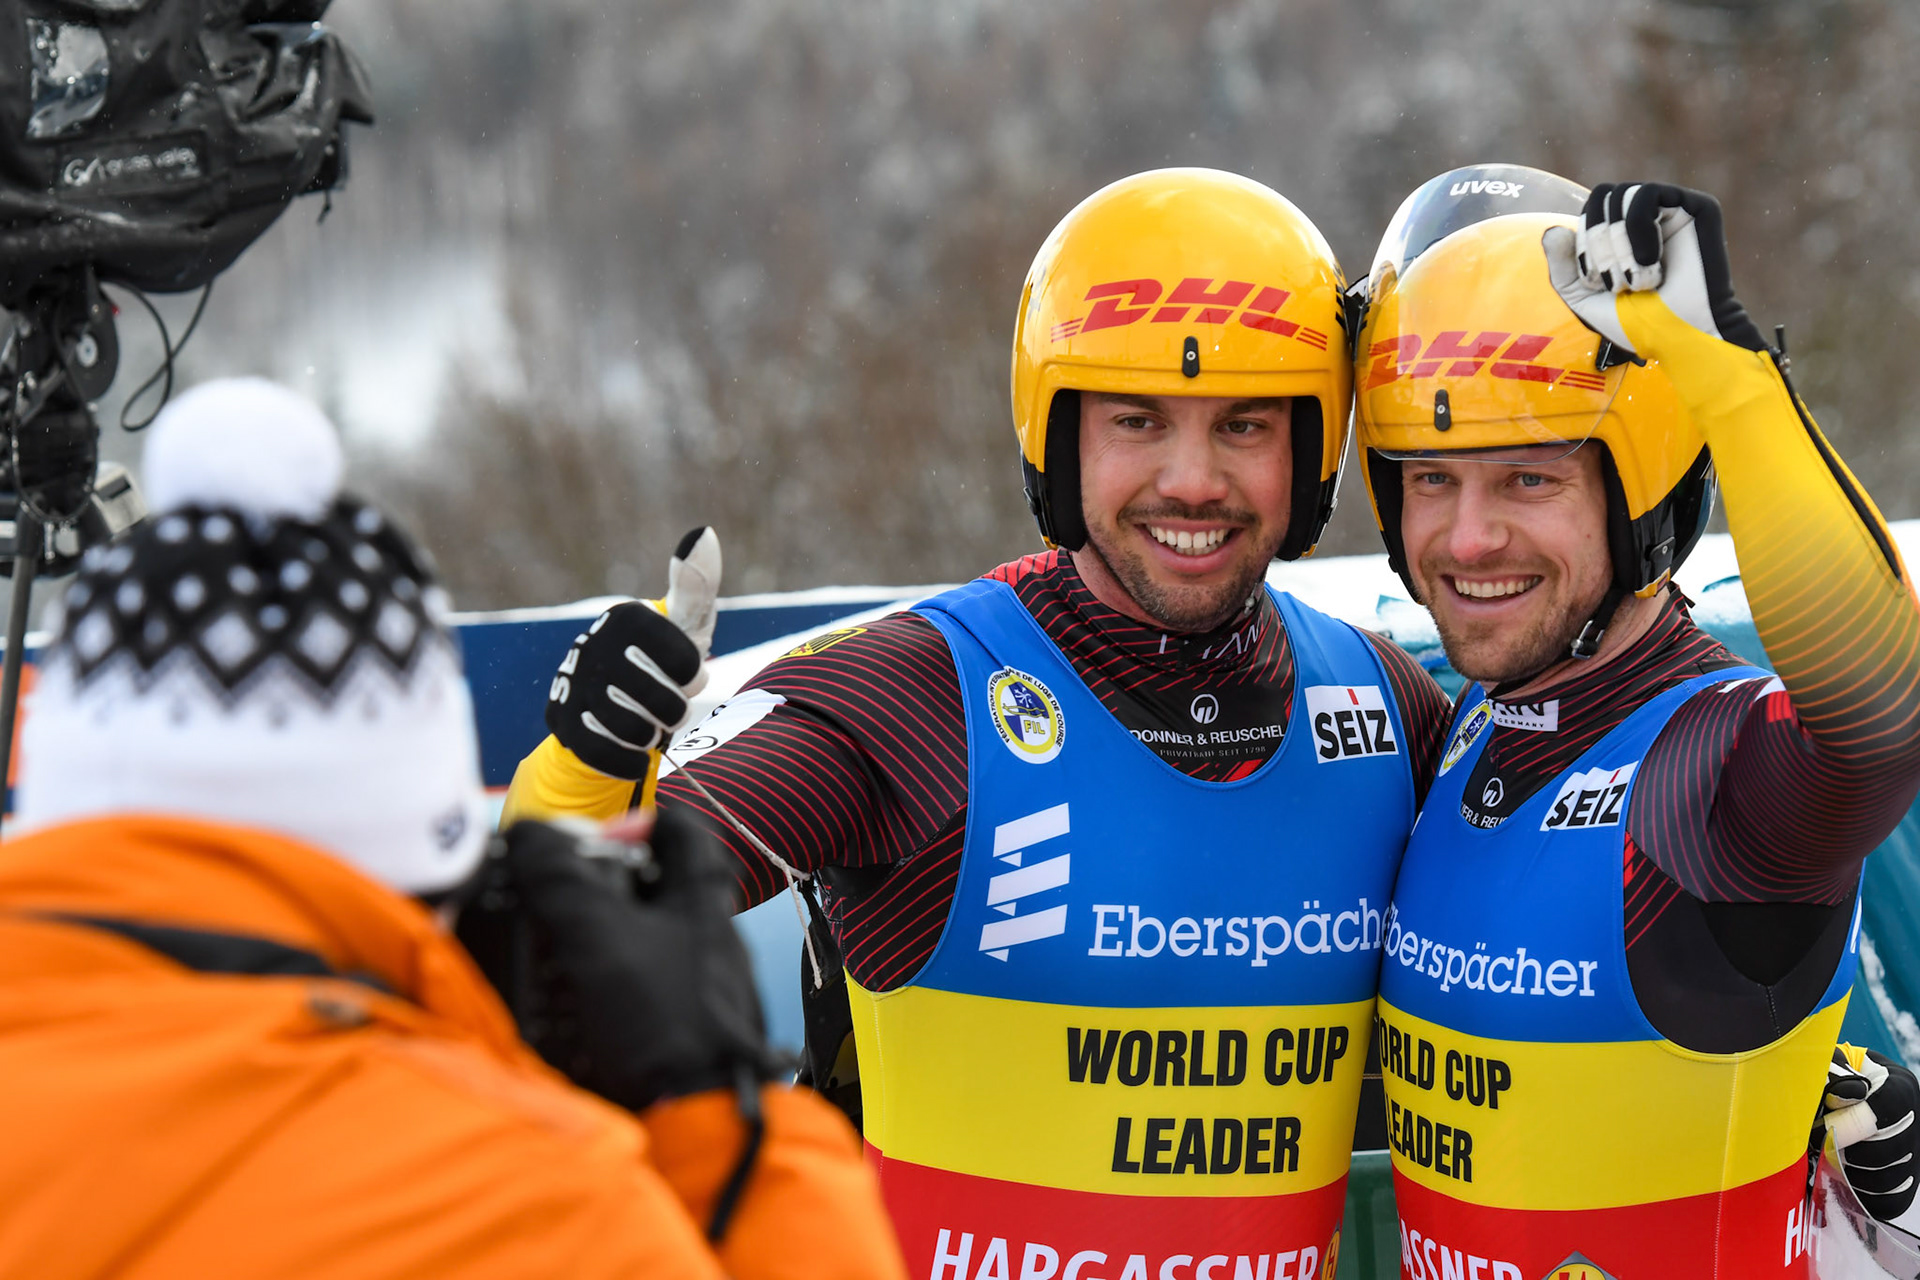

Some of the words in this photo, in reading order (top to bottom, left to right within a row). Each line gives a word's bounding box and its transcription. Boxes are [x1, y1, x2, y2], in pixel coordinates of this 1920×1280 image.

[1450, 179, 1524, 198] uvex
[1081, 278, 1300, 338] DHL
[1364, 331, 1566, 391] DHL
[1033, 681, 1053, 700] LUGE
[1023, 719, 1046, 735] FIL
[1130, 729, 1194, 746] DONNER
[1197, 733, 1208, 745] &
[1210, 725, 1285, 744] REUSCHEL
[1315, 709, 1396, 759] SEIZ
[1498, 717, 1545, 728] GERMANY
[1546, 783, 1627, 828] SEIZ
[1088, 898, 1389, 967] Eberspäch
[1385, 901, 1598, 997] berspächer
[1067, 1027, 1248, 1087] WORLD
[1264, 1026, 1349, 1086] CUP
[1379, 1017, 1435, 1091] ORLD
[1445, 1049, 1511, 1110] CUP
[1111, 1116, 1301, 1175] LEADER
